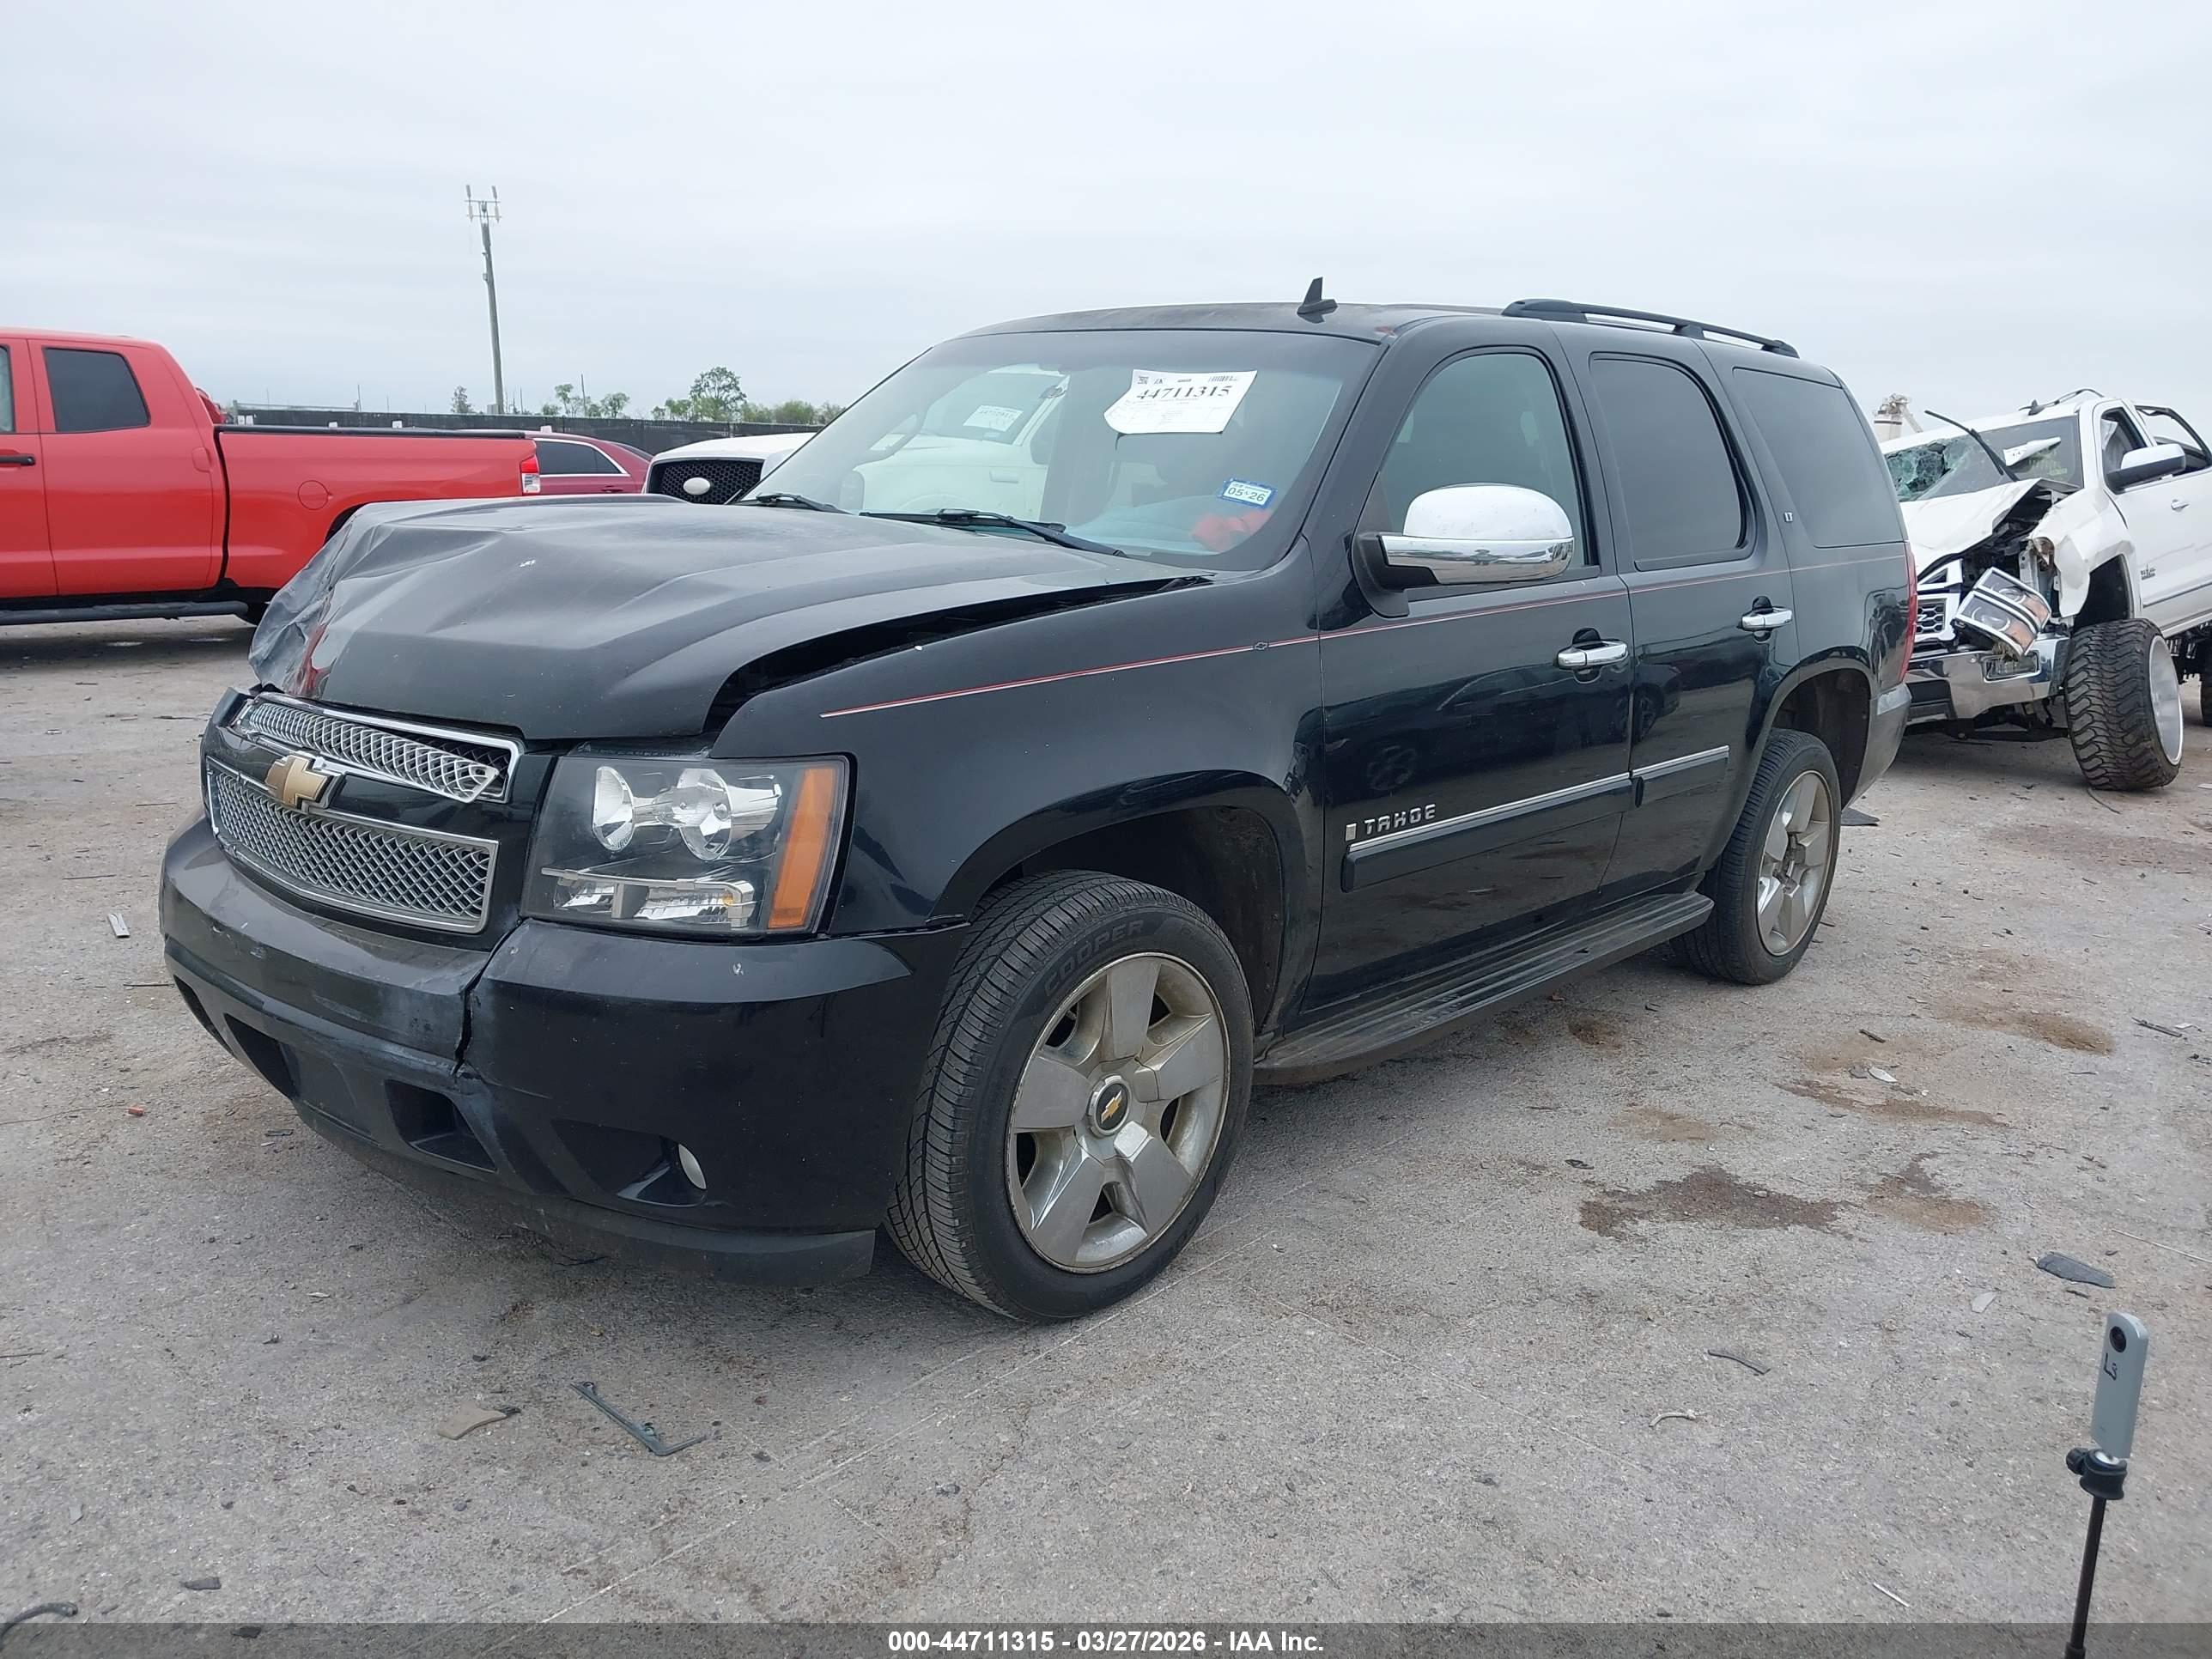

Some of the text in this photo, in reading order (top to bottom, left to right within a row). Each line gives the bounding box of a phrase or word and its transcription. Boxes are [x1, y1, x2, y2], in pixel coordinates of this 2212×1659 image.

[1136, 385, 1233, 400] 44711315
[1228, 487, 1244, 496] 05
[1249, 491, 1266, 501] 26
[1364, 803, 1437, 836] TAHOE
[1043, 919, 1145, 997] COOPER
